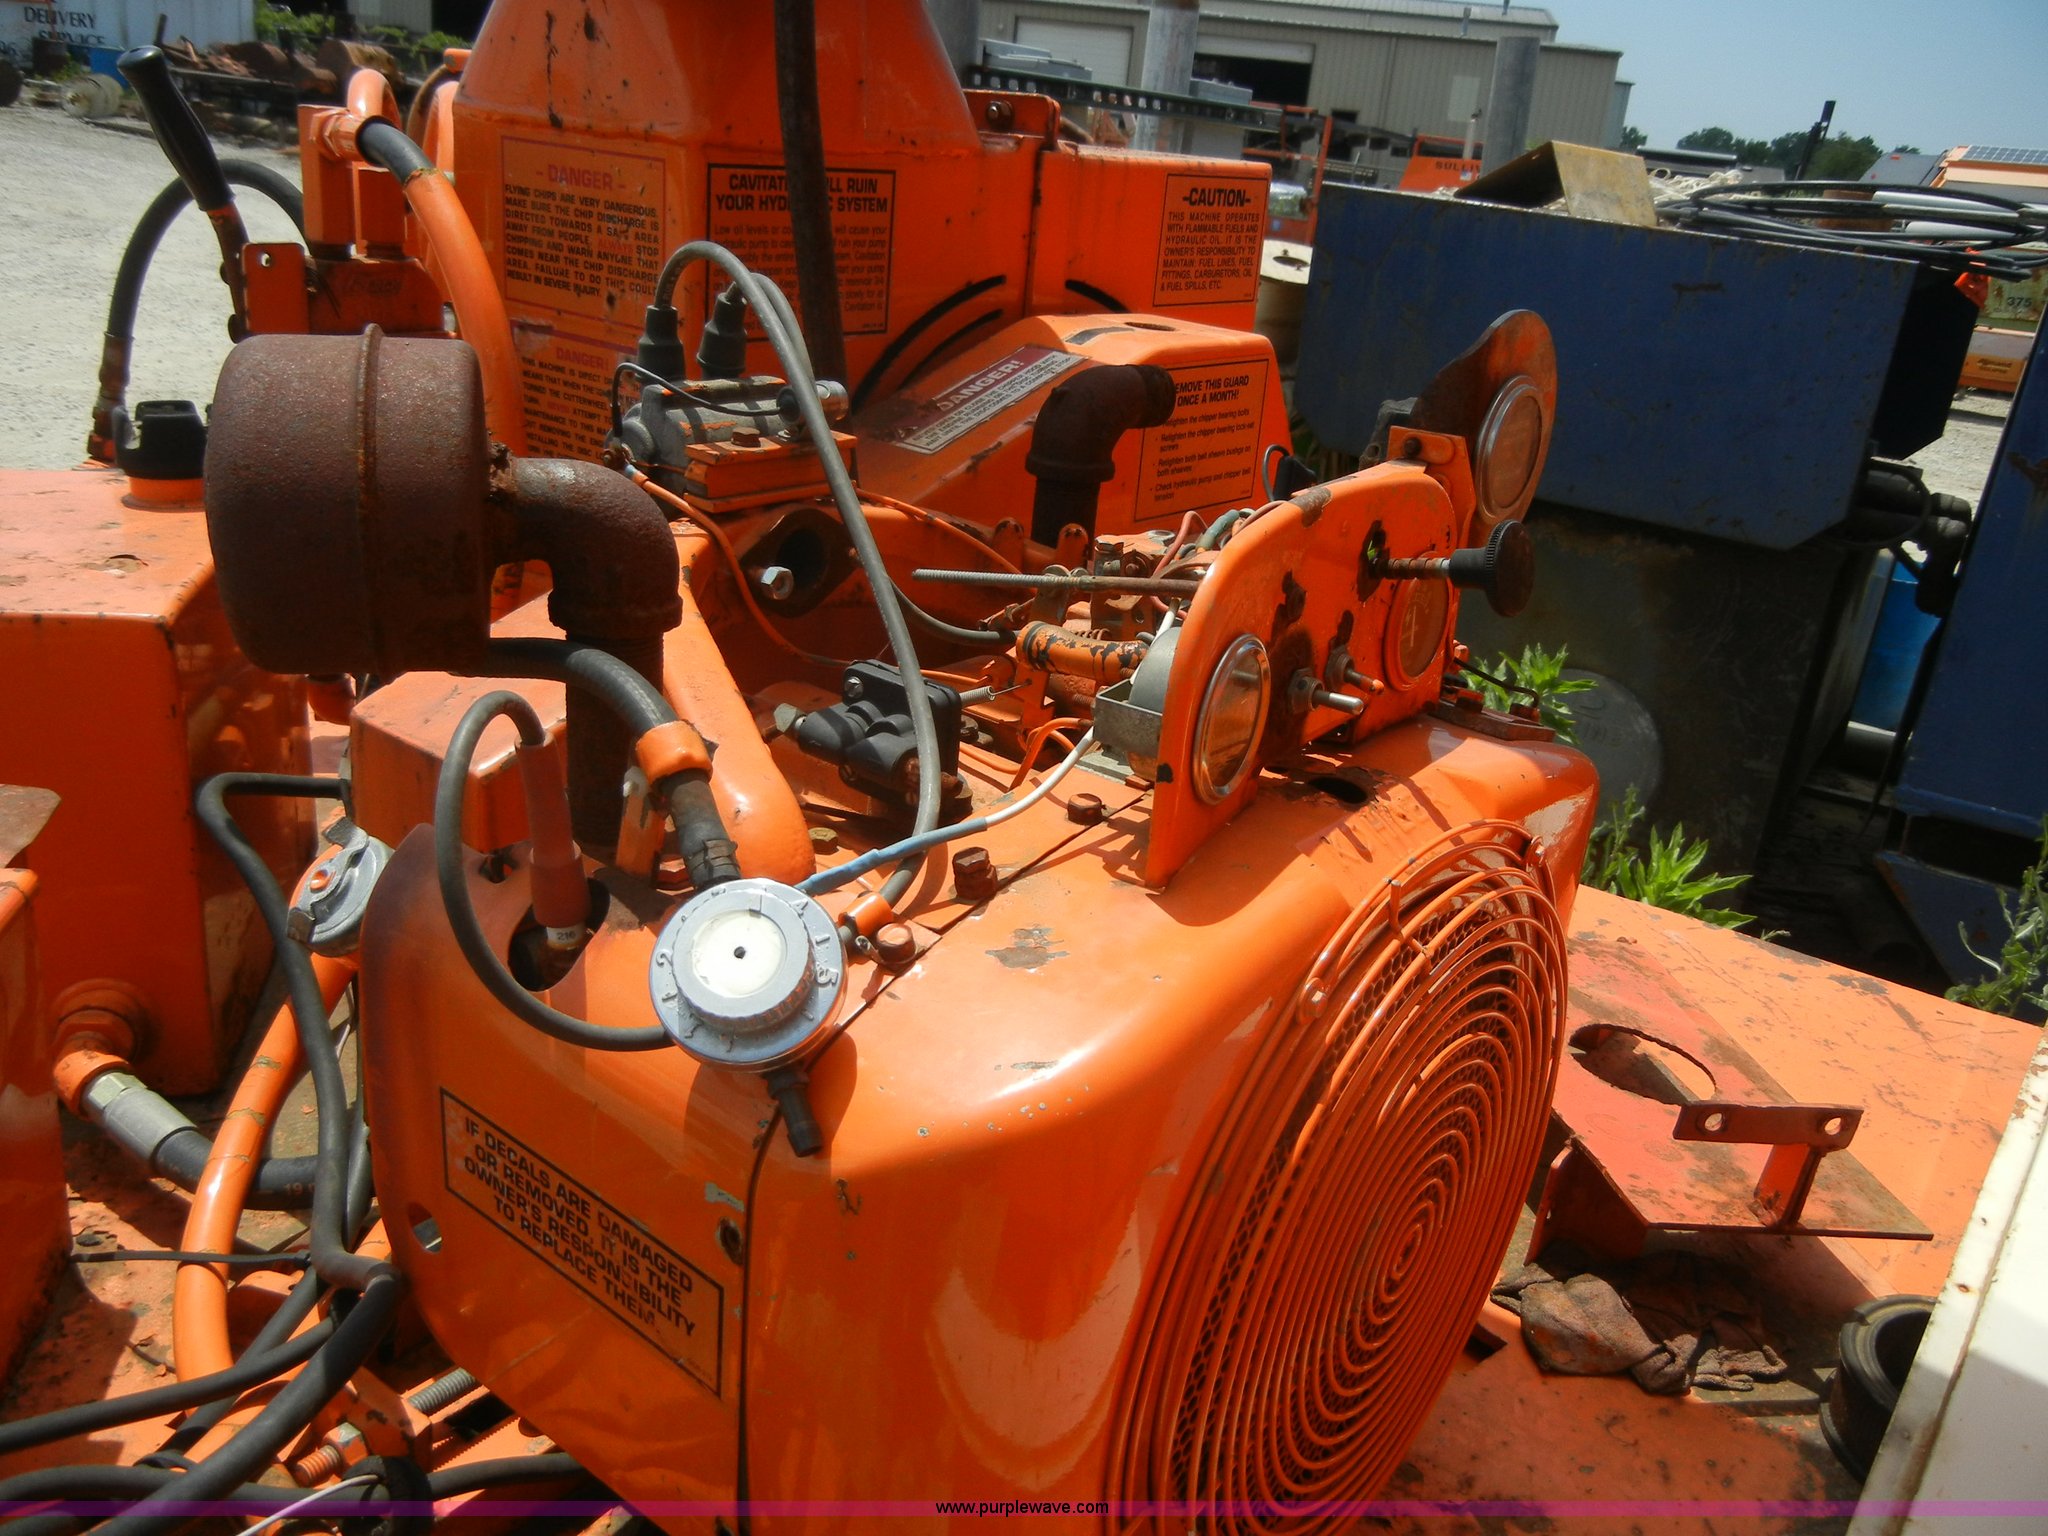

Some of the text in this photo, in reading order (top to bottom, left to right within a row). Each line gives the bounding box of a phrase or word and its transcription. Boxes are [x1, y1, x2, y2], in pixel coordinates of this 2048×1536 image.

[24, 7, 96, 29] DELIVERY
[729, 173, 788, 191] CAVITATI
[847, 178, 878, 194] RUIN
[505, 184, 530, 196] FLYING
[534, 189, 557, 200] CHIPS
[560, 194, 575, 204] ARE
[579, 197, 600, 208] VERY
[716, 195, 754, 211] YOUR
[837, 198, 888, 212] SYSTEM
[505, 197, 659, 231] MAKE SURE THE CHIP DISCHARGE IS
[1169, 212, 1260, 221] THIS MACHINE OPERATES
[505, 209, 546, 223] DIRECTED
[550, 216, 592, 233] TOWARDS
[635, 233, 659, 244] AREA
[1167, 224, 1183, 232] WITH
[1185, 224, 1223, 233] FLAMMABLE
[1225, 224, 1244, 232] FUELS
[505, 222, 528, 233] AWAY
[533, 226, 554, 237] FROM
[636, 245, 659, 256] STOP
[1166, 235, 1206, 244] HYDRAULIC
[1226, 236, 1232, 244] IT
[1245, 236, 1257, 244] THE
[506, 234, 659, 270] CHIPPING AND WARN ANYONE THAT
[506, 246, 534, 258] COMES
[538, 251, 560, 264] NEAR
[564, 256, 579, 267] THE
[584, 260, 604, 272] CHIP
[1164, 247, 1195, 256] OWNER'S
[1197, 247, 1245, 256] RESPONSIBILITY
[1199, 258, 1215, 267] FUEL
[1239, 258, 1253, 266] FUEL
[507, 270, 532, 282] RESULT
[534, 274, 541, 284] IN
[544, 277, 571, 291] SEVERE
[535, 263, 570, 278] FAILURE
[574, 271, 585, 281] TO
[590, 273, 600, 284] DO
[1167, 282, 1183, 291] FUEL
[2007, 296, 2032, 307] 375
[545, 375, 560, 384] THAT
[937, 360, 1025, 412] DANGER!
[1176, 375, 1249, 393] EMOVE THIS GUARD
[1177, 390, 1240, 407] ONCE A MONTH!
[569, 420, 578, 428] TO
[464, 1116, 694, 1294] IF DECALS ARE DAMAGED
[474, 1143, 498, 1172] OR
[622, 1251, 641, 1279] IS
[647, 1269, 682, 1307] THE
[464, 1156, 696, 1337] OWNER'S RESPONSIBILITY
[493, 1195, 516, 1223] TO
[520, 1214, 598, 1284] REPLACE
